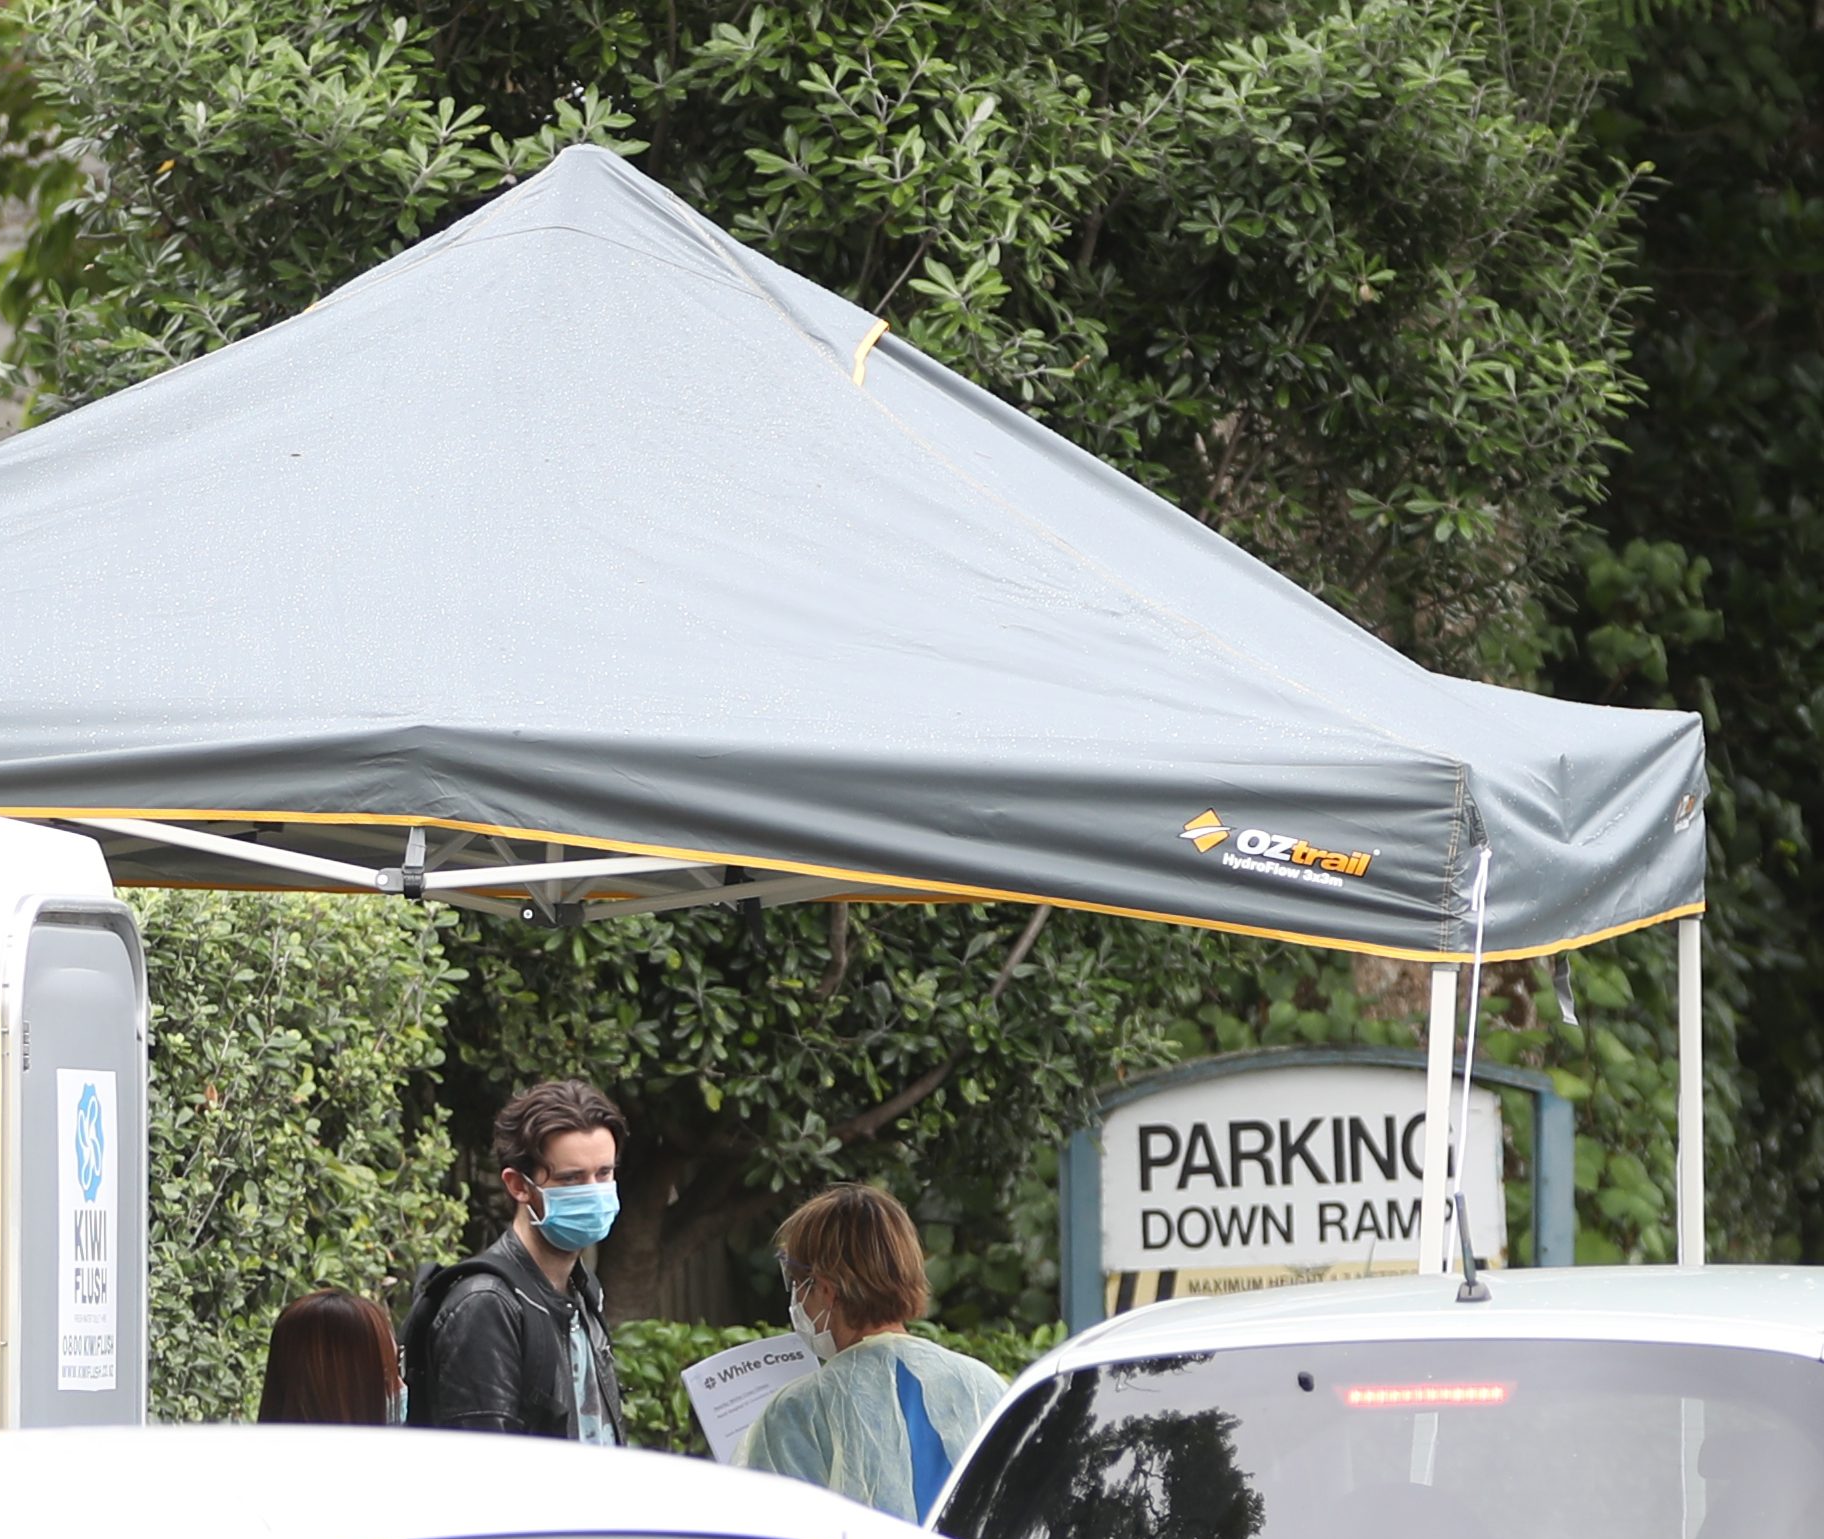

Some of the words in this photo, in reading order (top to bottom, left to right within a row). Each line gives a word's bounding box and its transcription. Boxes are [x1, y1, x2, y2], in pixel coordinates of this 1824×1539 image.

[1222, 852, 1299, 881] HydroFlow
[1302, 869, 1344, 888] 3x3m
[1236, 828, 1372, 877] OZtrail
[74, 1210, 107, 1261] KIWI
[1142, 1203, 1293, 1250] DOWN
[74, 1267, 107, 1304] FLUSH
[717, 1361, 762, 1384] White
[763, 1349, 804, 1367] Cross
